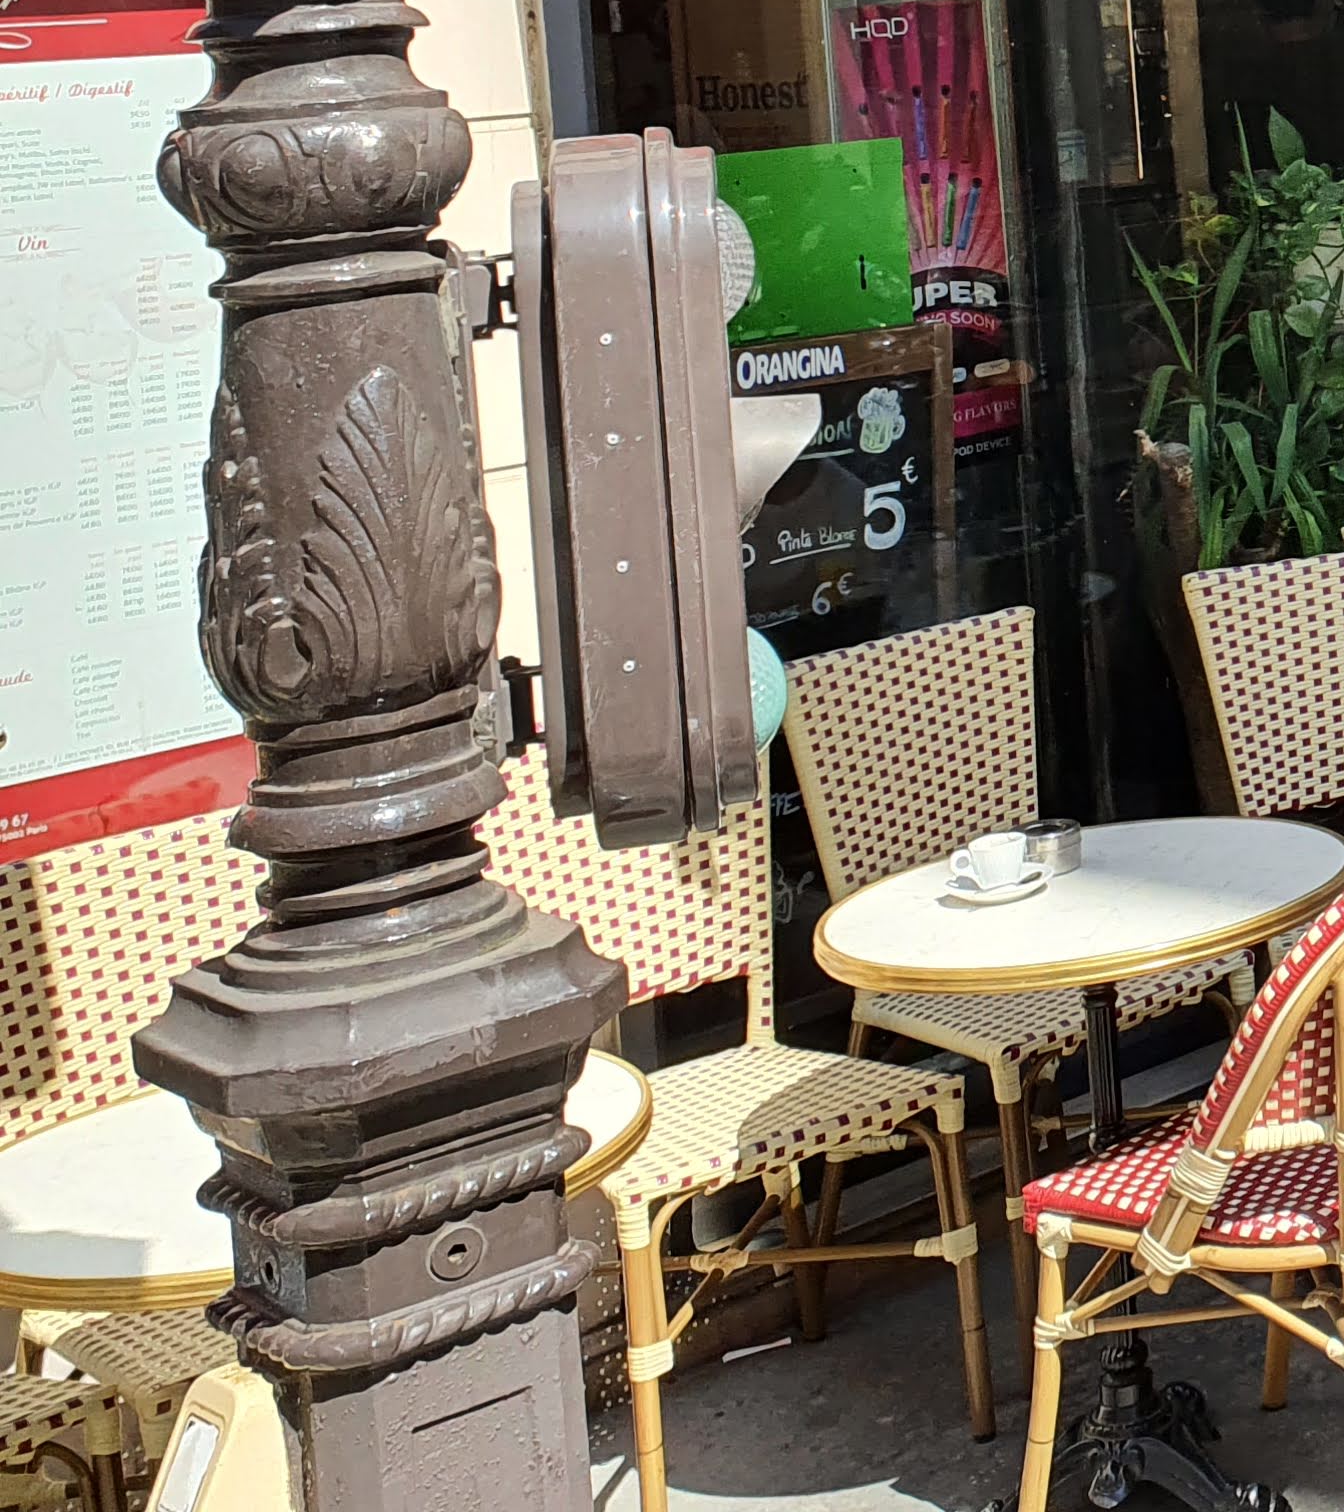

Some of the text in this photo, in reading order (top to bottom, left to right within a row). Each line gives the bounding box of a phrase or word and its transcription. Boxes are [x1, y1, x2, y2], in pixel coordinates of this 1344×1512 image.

[850, 17, 909, 39] HQD
[951, 310, 996, 331] SOON
[736, 344, 846, 390] ORANGINA
